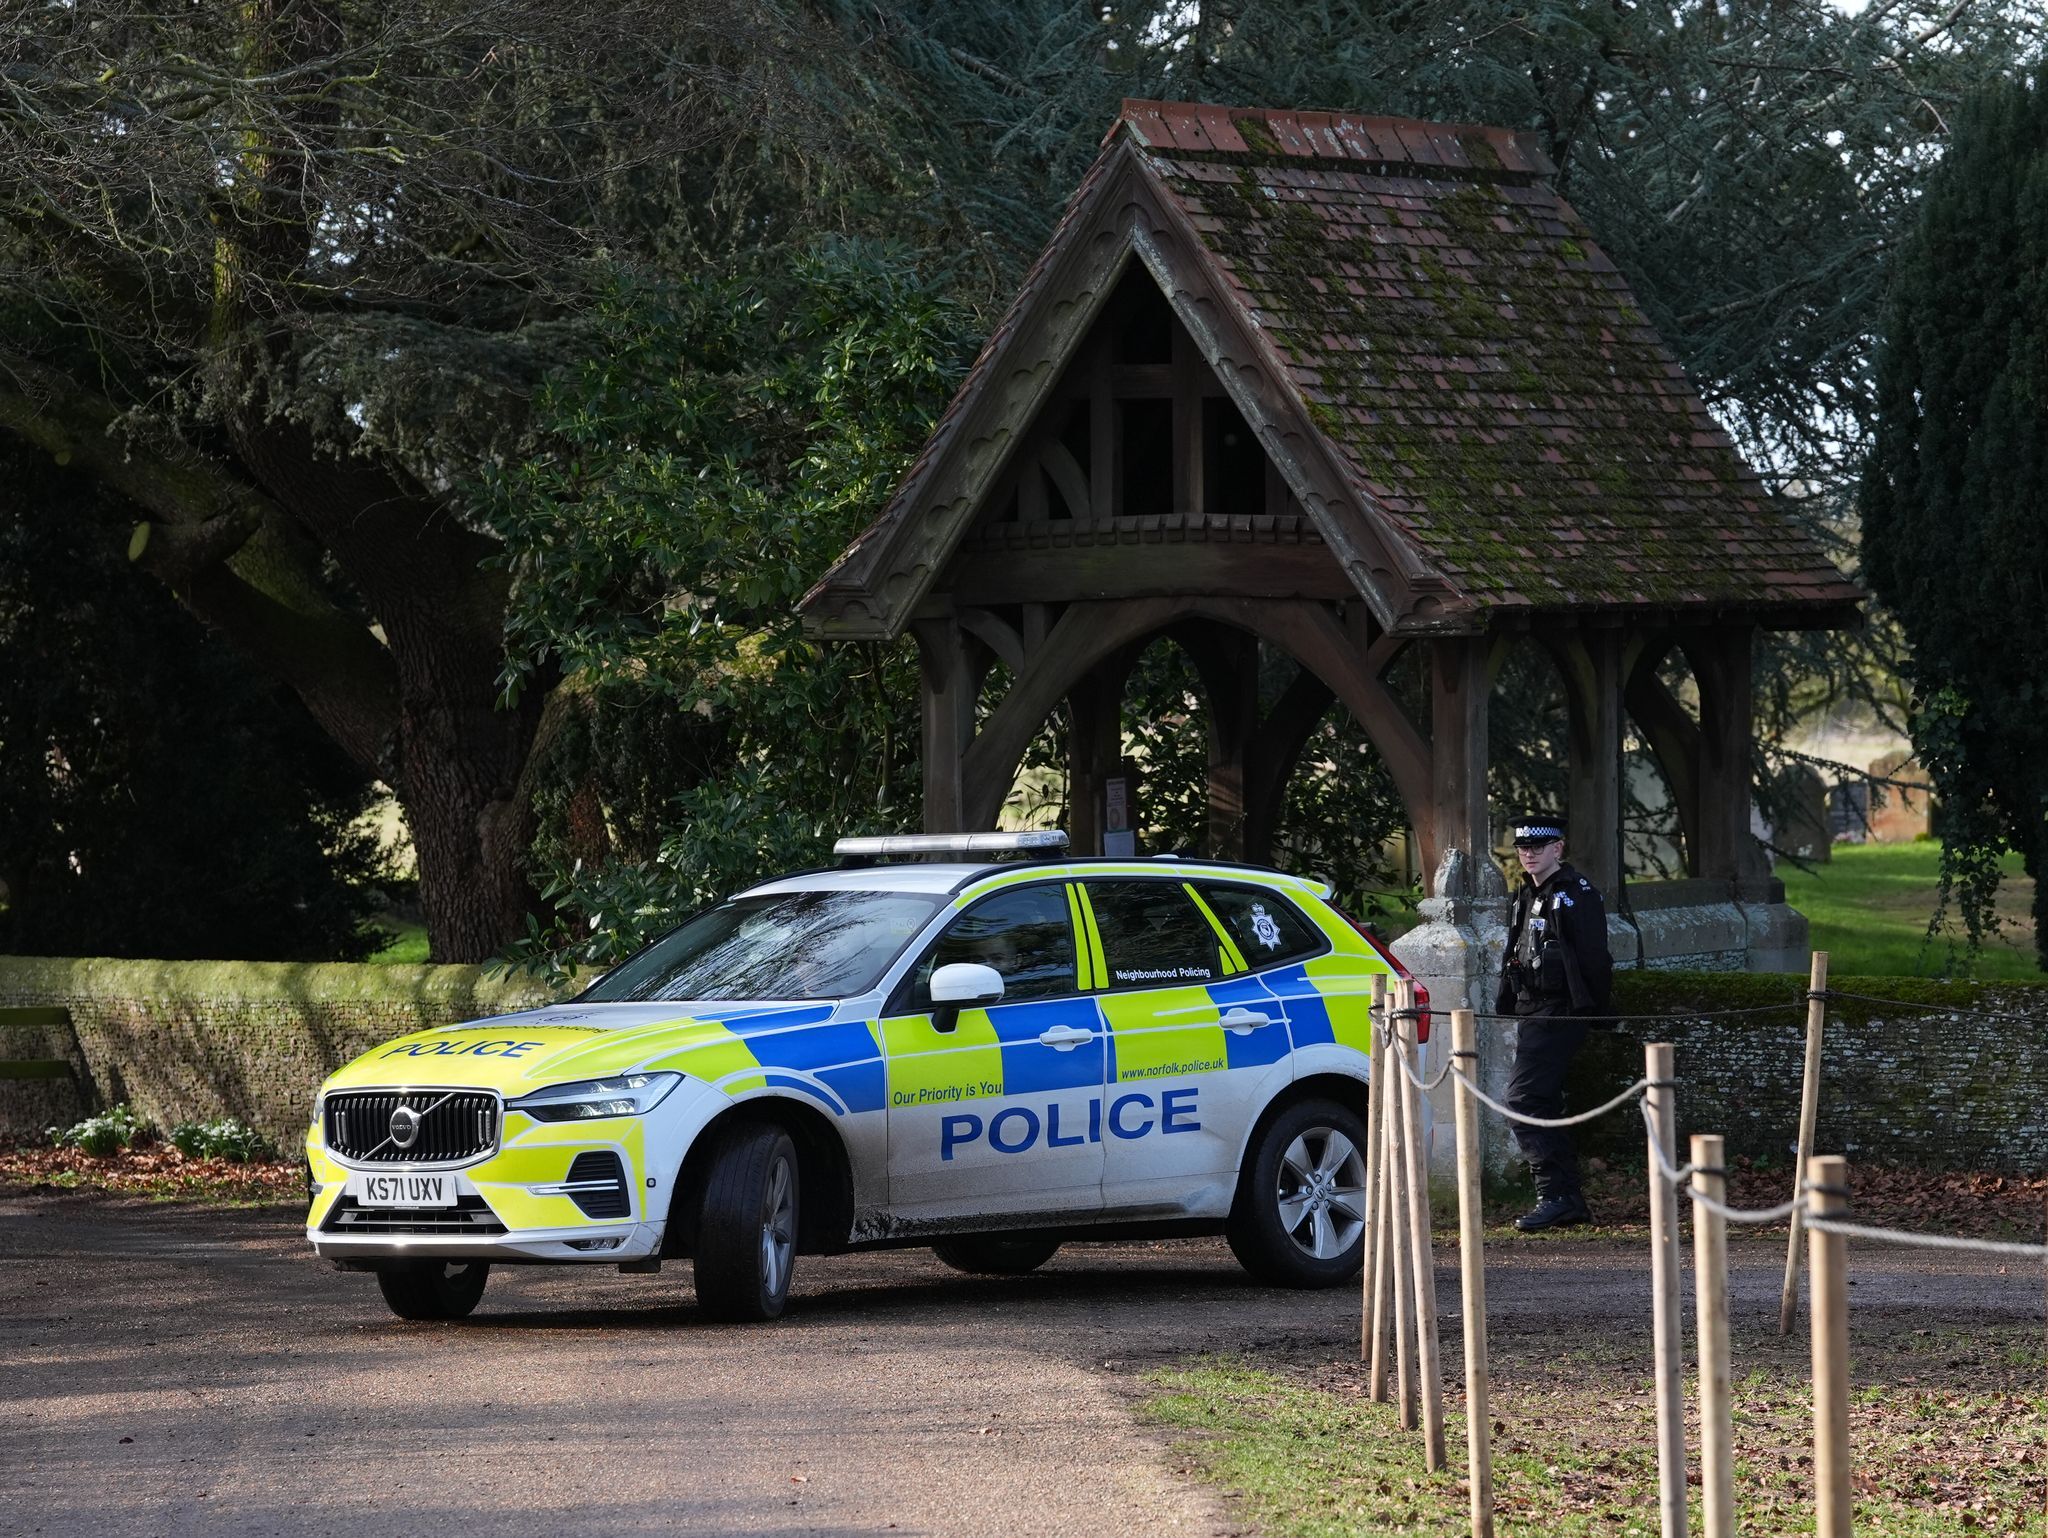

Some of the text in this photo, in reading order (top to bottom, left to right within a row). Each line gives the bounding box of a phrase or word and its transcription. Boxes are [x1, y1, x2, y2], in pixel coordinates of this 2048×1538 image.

[1115, 967, 1211, 981] Neighbourhood Policing
[379, 1040, 546, 1060] POLICE
[1121, 1058, 1224, 1079] www.norfolk.police.uk
[893, 1081, 1002, 1105] Our Priority is You
[941, 1087, 1201, 1161] POLICE
[366, 1177, 442, 1201] KS71 UXV
